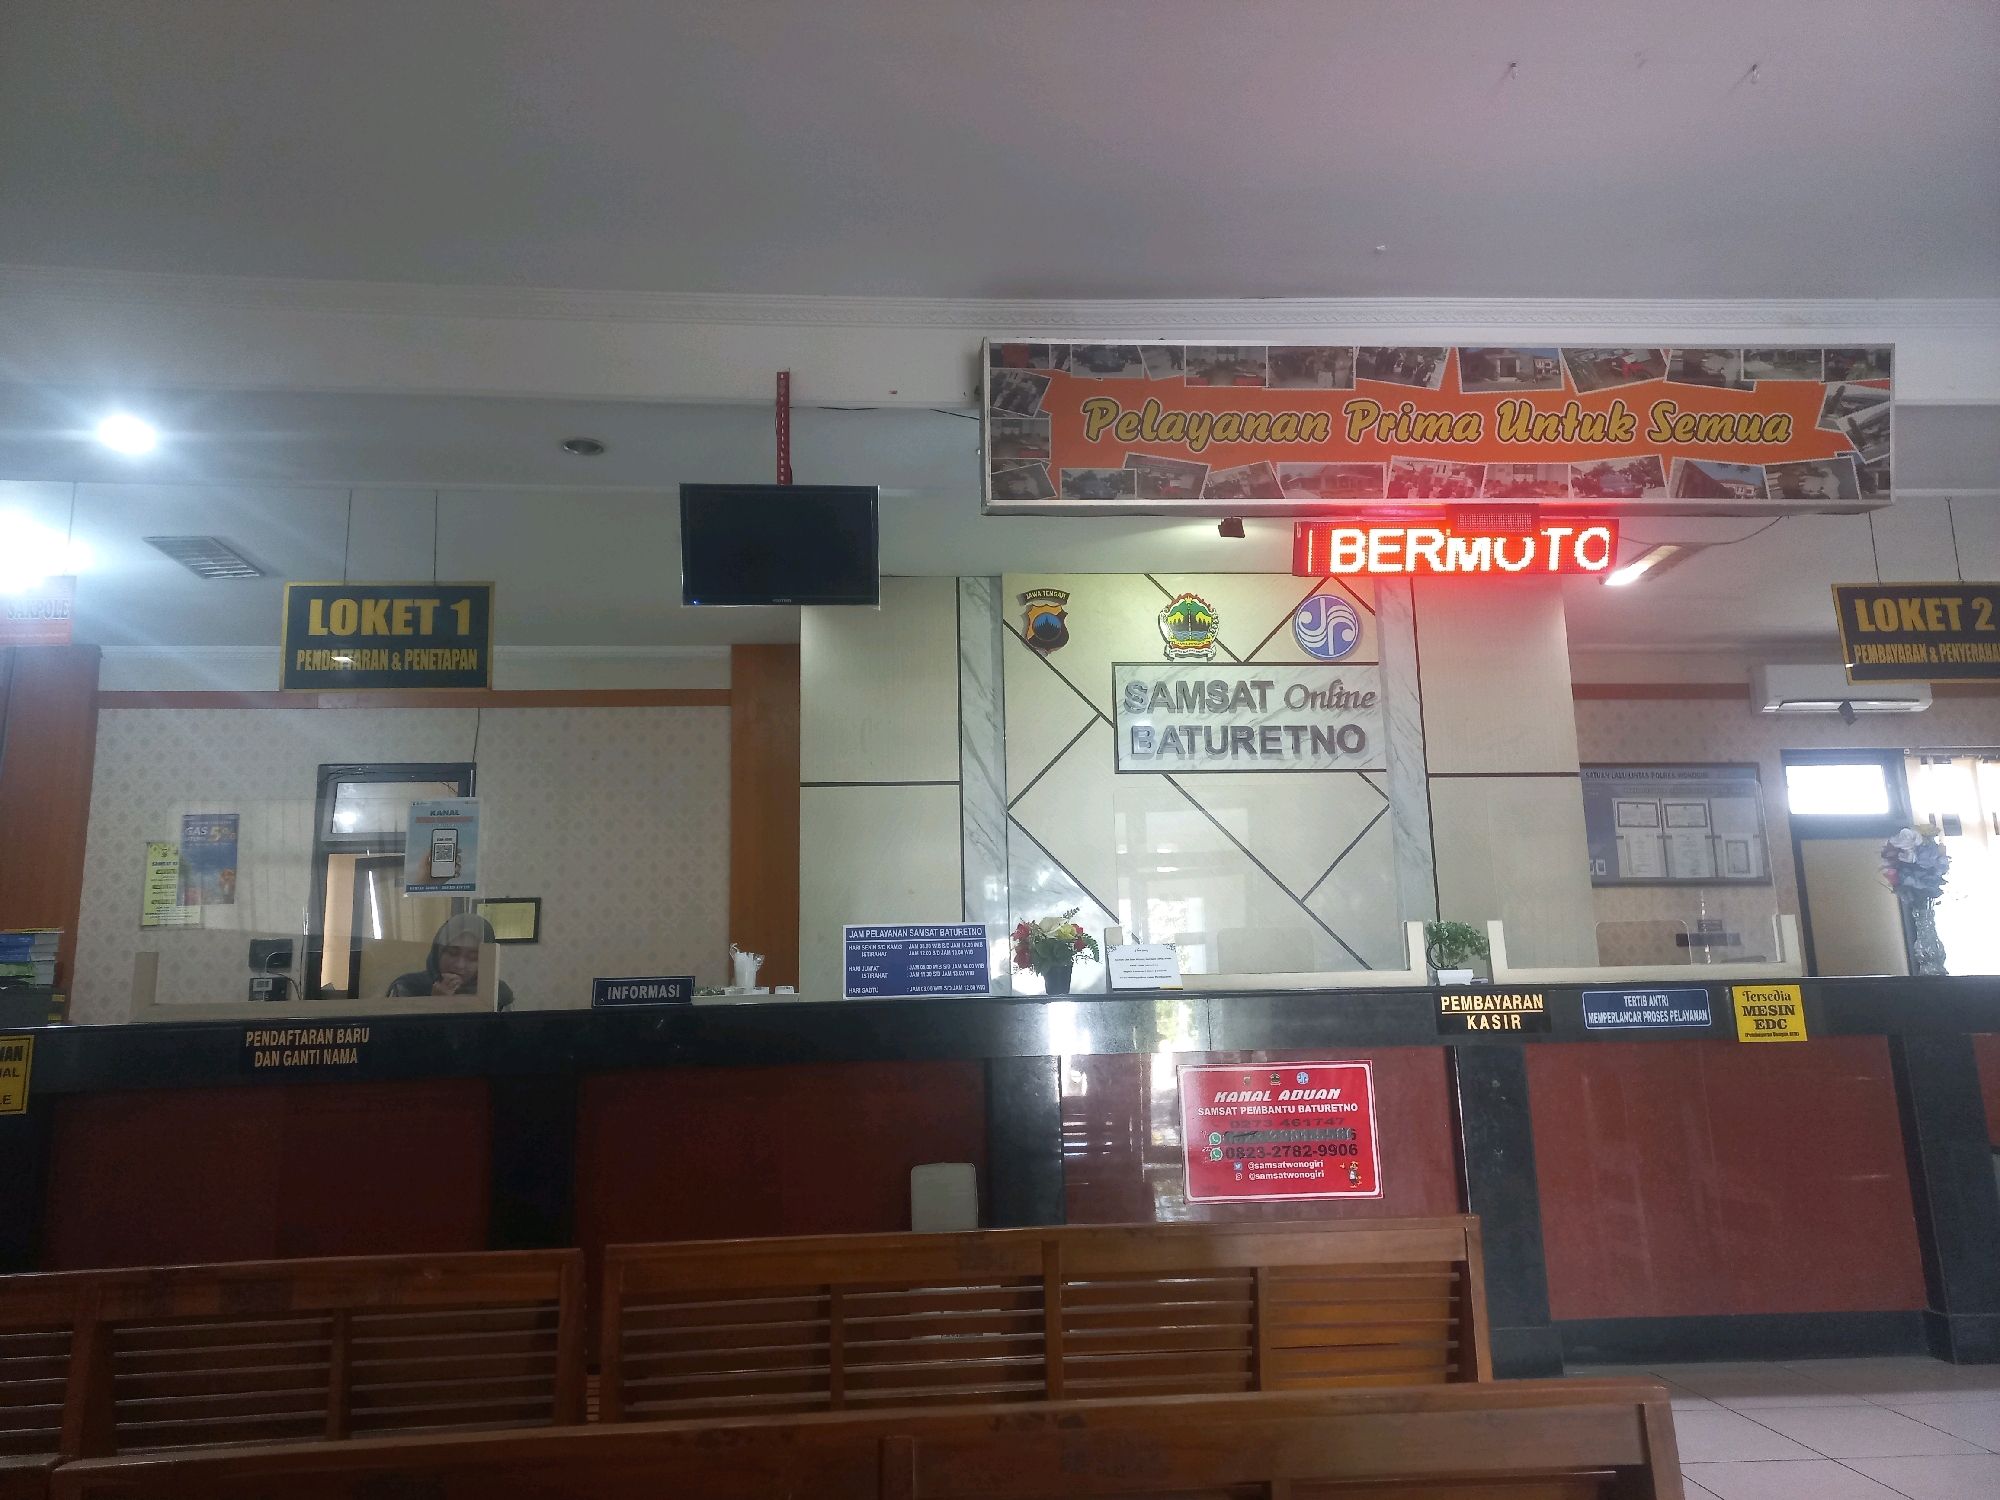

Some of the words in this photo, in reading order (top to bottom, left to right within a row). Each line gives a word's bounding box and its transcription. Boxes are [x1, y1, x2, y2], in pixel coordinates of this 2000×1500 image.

[1082, 397, 1331, 452] Pelayanan
[1343, 398, 1483, 443] Prima
[1495, 399, 1638, 444] Untuk
[1645, 399, 1792, 444] Semua
[308, 598, 440, 636] LOKET
[450, 599, 471, 636] 1
[1855, 597, 1962, 632] LOKET
[1971, 596, 1996, 631] 2
[296, 649, 388, 671] PENDAFTARAN
[391, 651, 402, 671] &
[404, 649, 477, 671] PENETAPAN
[1853, 643, 1928, 664] PEMBAYARAN
[1929, 646, 1939, 664] &
[1939, 643, 2000, 664] PENYERAHA
[1124, 680, 1274, 712] SAMSAT
[1283, 678, 1376, 711] Online
[1131, 723, 1366, 757] BATURETNO
[1585, 771, 1610, 779] SATUAN
[1612, 771, 1627, 779] LALU
[866, 929, 908, 938] PELAYANAN
[940, 928, 982, 936] BATURETNO
[608, 984, 680, 1000] INFORMASI
[1742, 990, 1791, 1002] Tersedia
[1440, 994, 1543, 1010] PEMBAYARAN
[1624, 996, 1647, 1007] TERTIB
[1649, 995, 1669, 1006] ANTRI
[1588, 1011, 1642, 1023] MEMPERLANCAR
[1643, 1010, 1668, 1023] PROSES
[1670, 1010, 1708, 1022] PELAYANAN
[1741, 1005, 1795, 1016] MESIN
[1467, 1014, 1521, 1029] KASIR
[1754, 1019, 1787, 1029] EDC
[246, 1030, 333, 1047] PENDAFTARAN
[337, 1028, 370, 1043] BARU
[254, 1050, 279, 1067] DAN
[284, 1050, 320, 1066] GANTI
[323, 1048, 357, 1065] NAMA
[1214, 1090, 1272, 1103] KANAL
[1278, 1088, 1342, 1101] ADUAN
[1198, 1106, 1238, 1116] SAMSAT
[1240, 1105, 1295, 1115] PEMBANTU
[1298, 1103, 1358, 1113] BATURETNO
[1230, 1120, 1273, 1128] 0273
[1280, 1118, 1346, 1127] 461747
[1225, 1144, 1358, 1159] 0823-2782-9906
[1248, 1160, 1324, 1170] @samsatwonogiri
[1249, 1170, 1324, 1180] @samsatwonogiri
